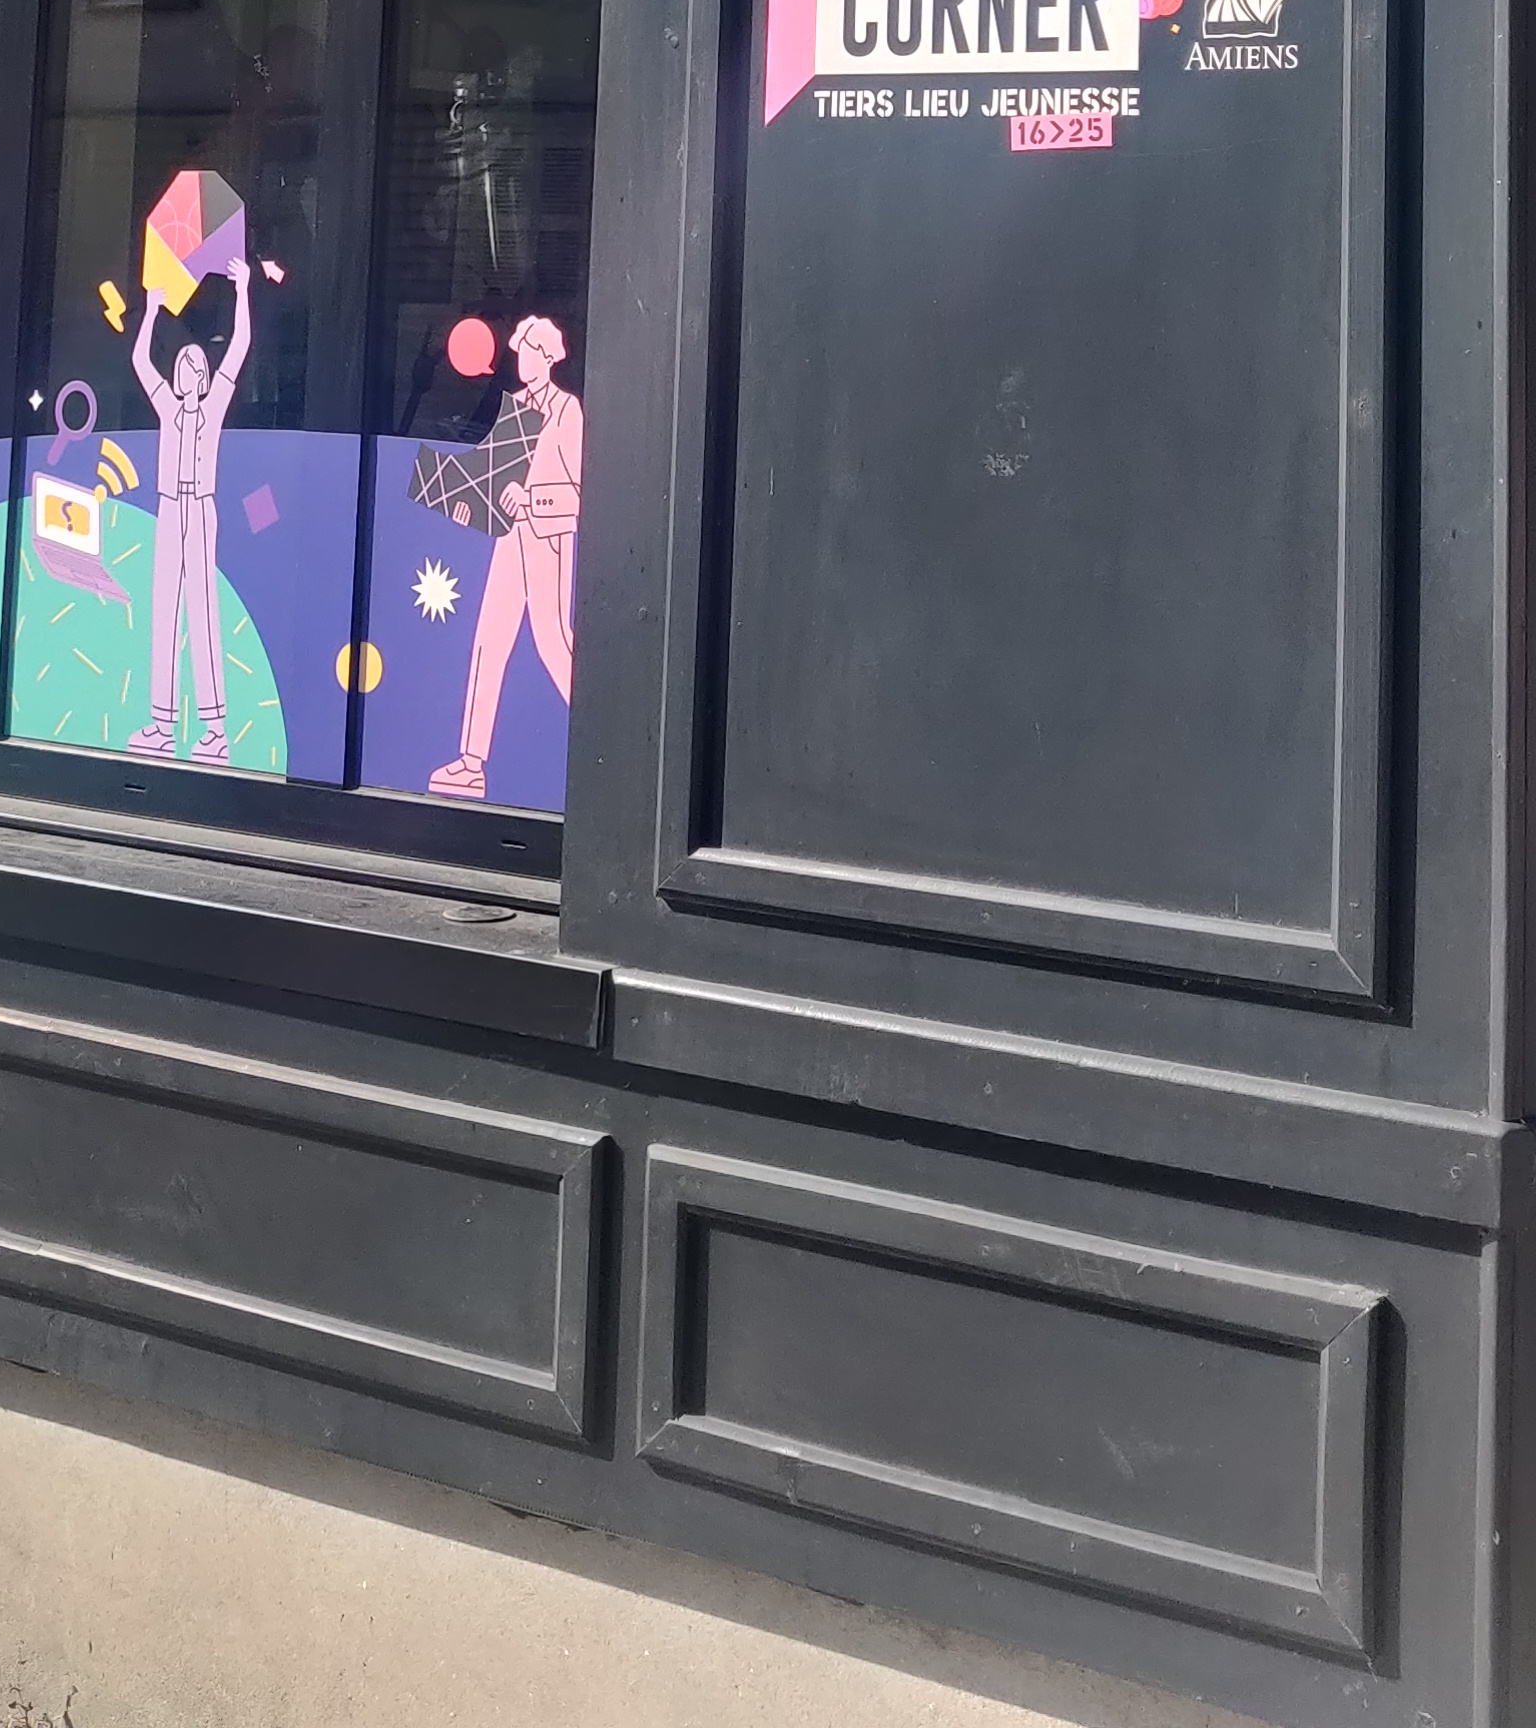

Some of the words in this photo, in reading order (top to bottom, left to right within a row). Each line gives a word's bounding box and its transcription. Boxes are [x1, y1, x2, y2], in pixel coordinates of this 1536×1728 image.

[1184, 42, 1299, 72] AMIENS
[814, 89, 895, 119] TIERS
[904, 88, 970, 119] LIEU
[981, 87, 1140, 118] JEUNESSE
[1016, 117, 1106, 147] 16>25
